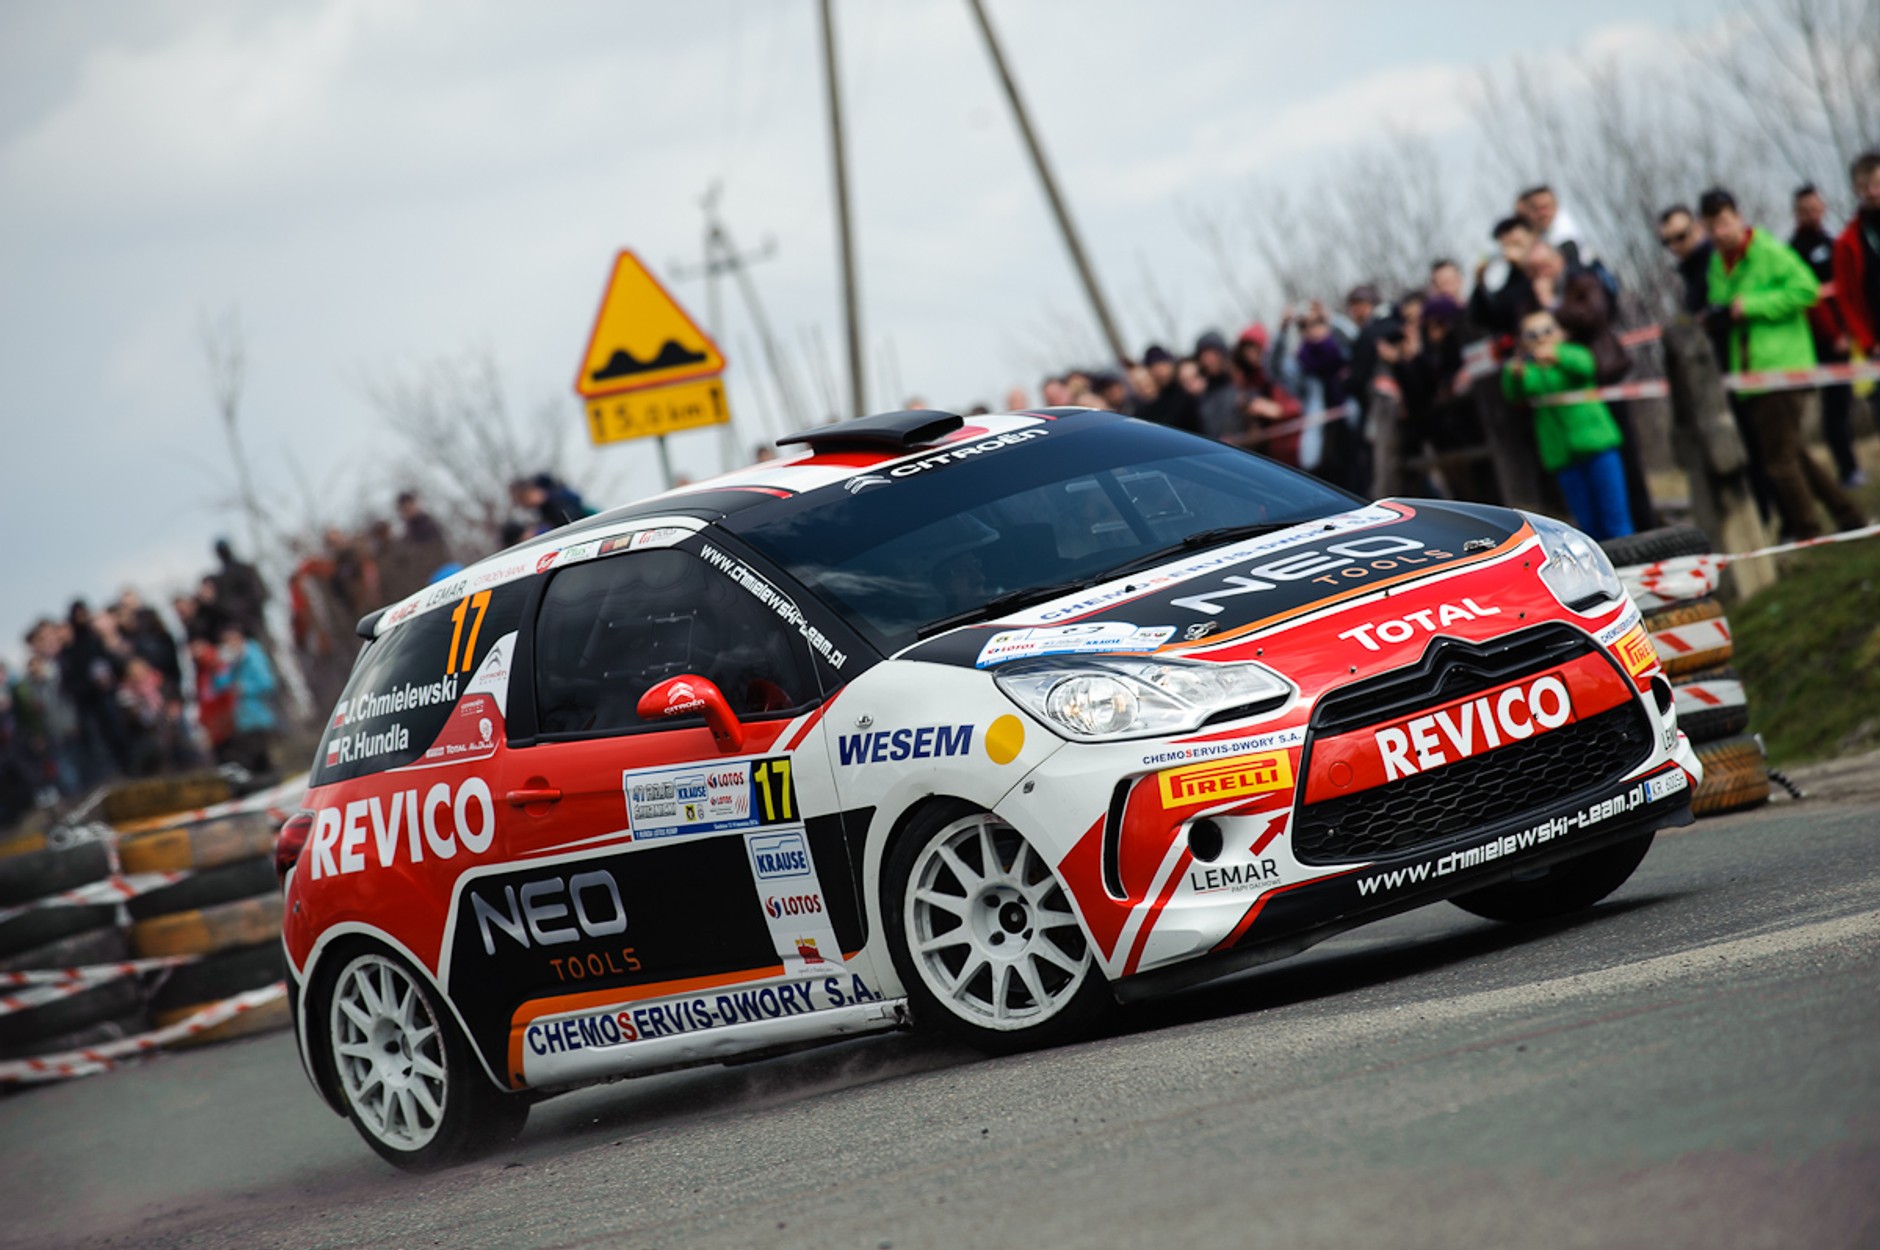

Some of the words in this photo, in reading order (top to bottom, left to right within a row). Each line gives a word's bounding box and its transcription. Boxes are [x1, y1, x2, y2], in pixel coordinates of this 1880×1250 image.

[1170, 536, 1425, 615] NEO
[1312, 549, 1453, 585] TOOLS
[426, 579, 467, 607] LEMAR
[446, 589, 492, 675] 17
[1338, 598, 1501, 651] TOTAL
[344, 672, 458, 725] J.Chmielewski
[339, 723, 409, 764] R.Hundla
[838, 724, 975, 766] WESEM
[1374, 675, 1572, 782] REVICO
[1142, 738, 1274, 765] CHEMOSERVIS-DWORY
[678, 786, 707, 799] KRAUSE
[717, 771, 744, 787] LOTOS
[754, 760, 793, 821] 17
[1170, 758, 1278, 800] PIRELLI
[310, 776, 495, 880] REVICO
[1357, 784, 1644, 896] www.chmielewski-team.pl
[756, 850, 807, 873] KRAUSE
[1191, 859, 1279, 891] LEMAR
[470, 869, 628, 956] NEO
[781, 894, 822, 915] LOTOS
[550, 947, 642, 981] TOOLS
[528, 981, 812, 1056] CHEMOSERVIS-DWORY
[824, 973, 883, 1005] S.A.
